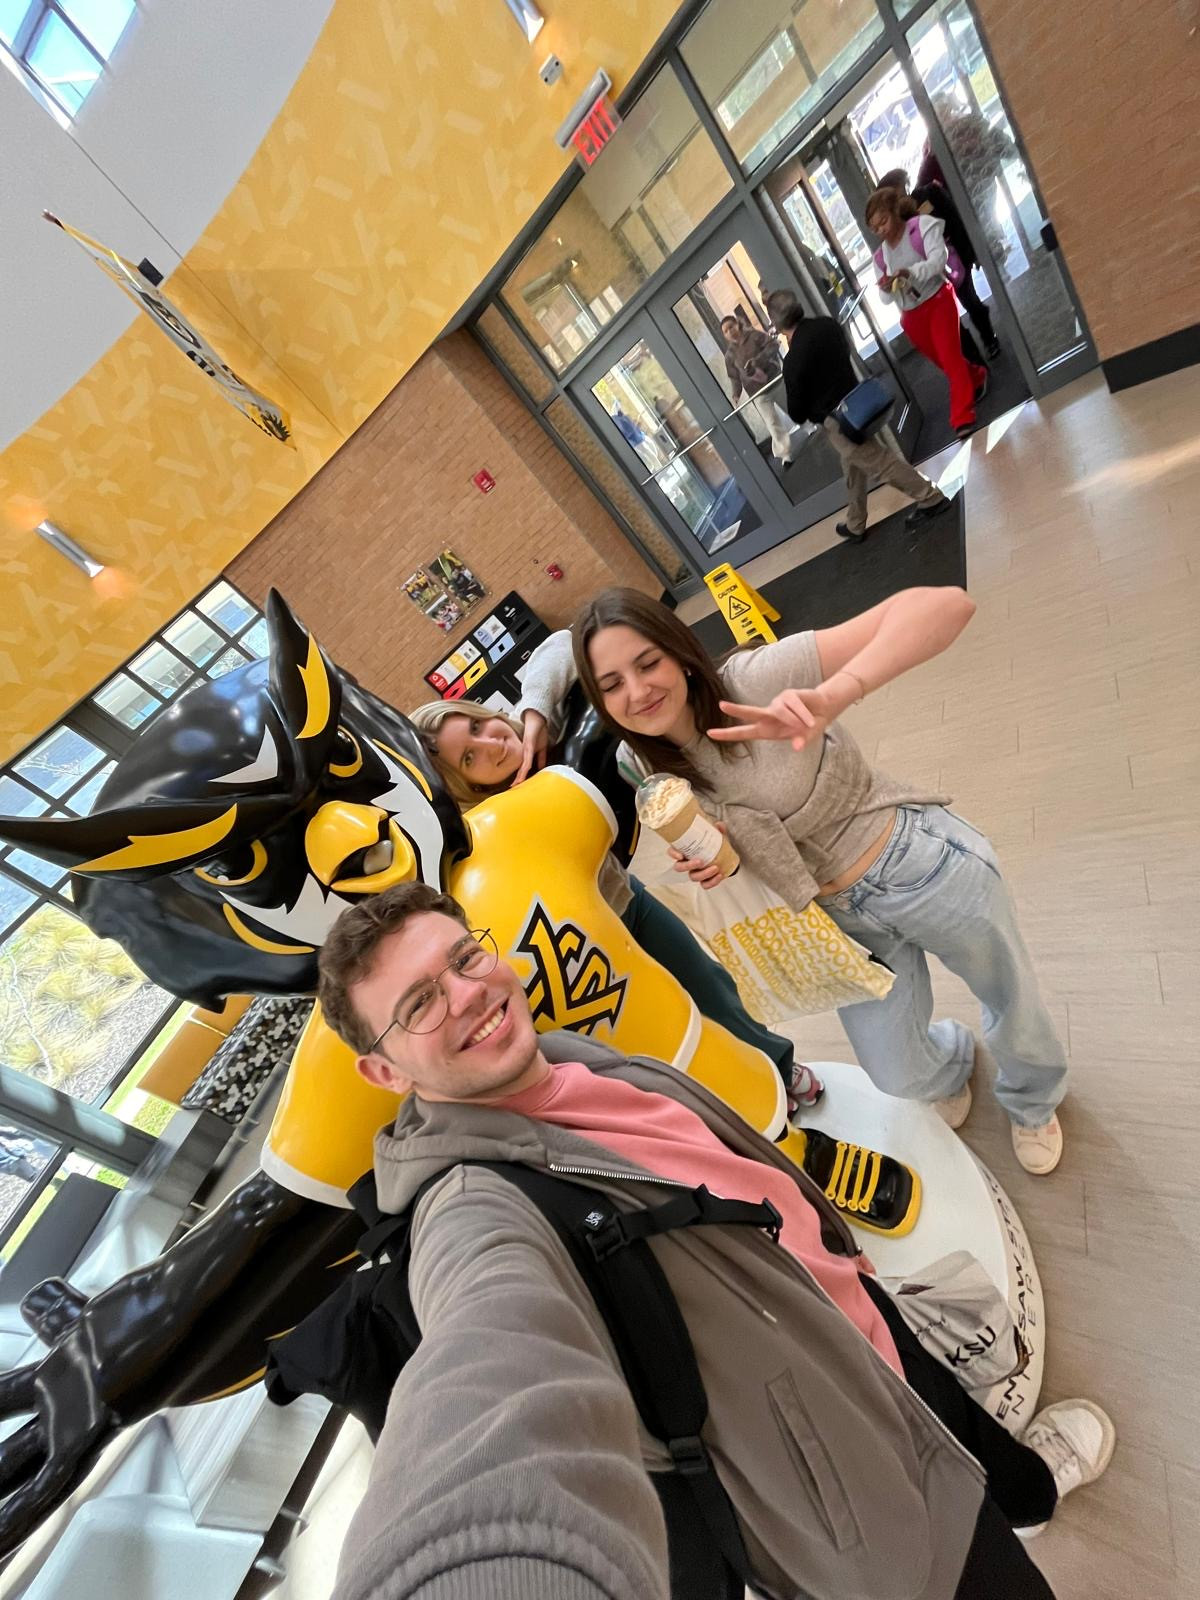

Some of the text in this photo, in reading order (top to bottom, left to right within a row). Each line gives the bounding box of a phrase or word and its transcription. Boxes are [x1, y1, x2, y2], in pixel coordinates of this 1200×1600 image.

[572, 98, 617, 166] EXIT
[717, 584, 738, 599] CAUTION
[944, 1325, 997, 1367] KSU
[995, 1253, 1027, 1421] ENSAW
